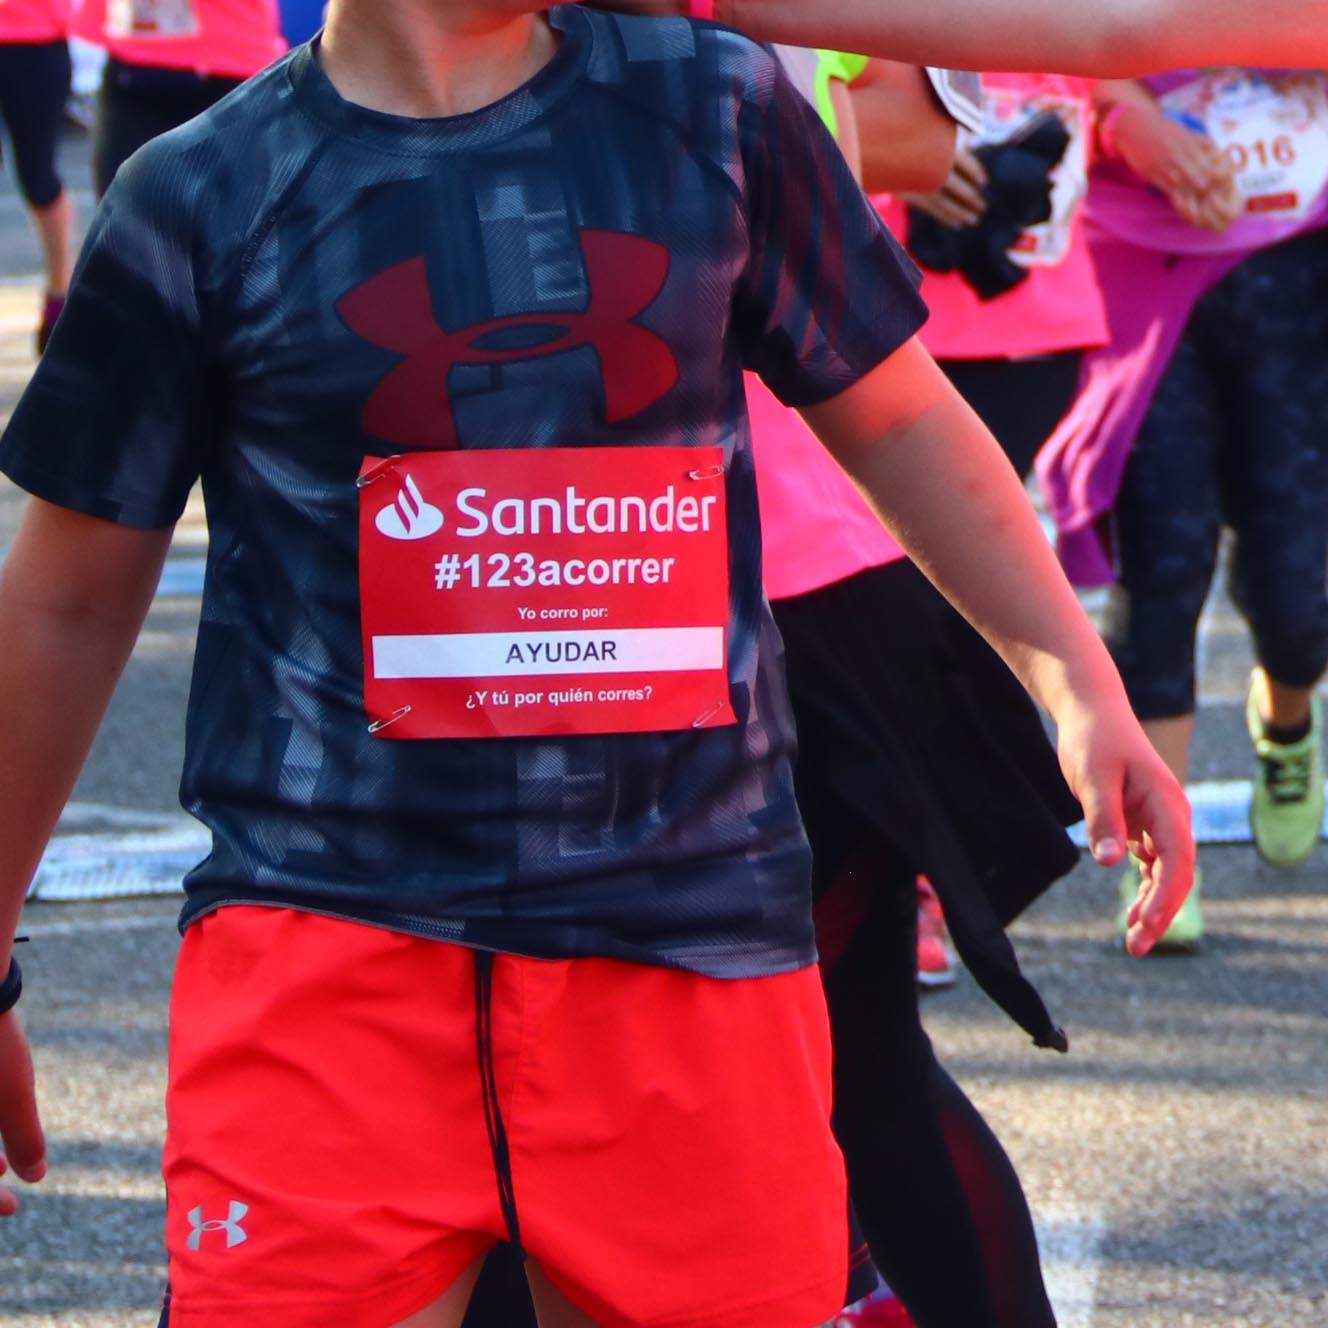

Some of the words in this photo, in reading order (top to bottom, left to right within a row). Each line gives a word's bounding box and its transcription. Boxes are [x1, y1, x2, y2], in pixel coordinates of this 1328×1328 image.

[1227, 135, 1297, 171] 016
[456, 484, 717, 538] Santander
[433, 552, 676, 590] #123acorrer
[518, 606, 536, 620] Yo
[540, 607, 578, 619] corro
[582, 606, 609, 621] por:
[505, 640, 617, 664] AYUDAR
[466, 690, 490, 709] ¿Y
[492, 688, 510, 706] tú
[514, 690, 543, 708] por
[548, 686, 594, 706] quién
[597, 685, 653, 702] corres?
